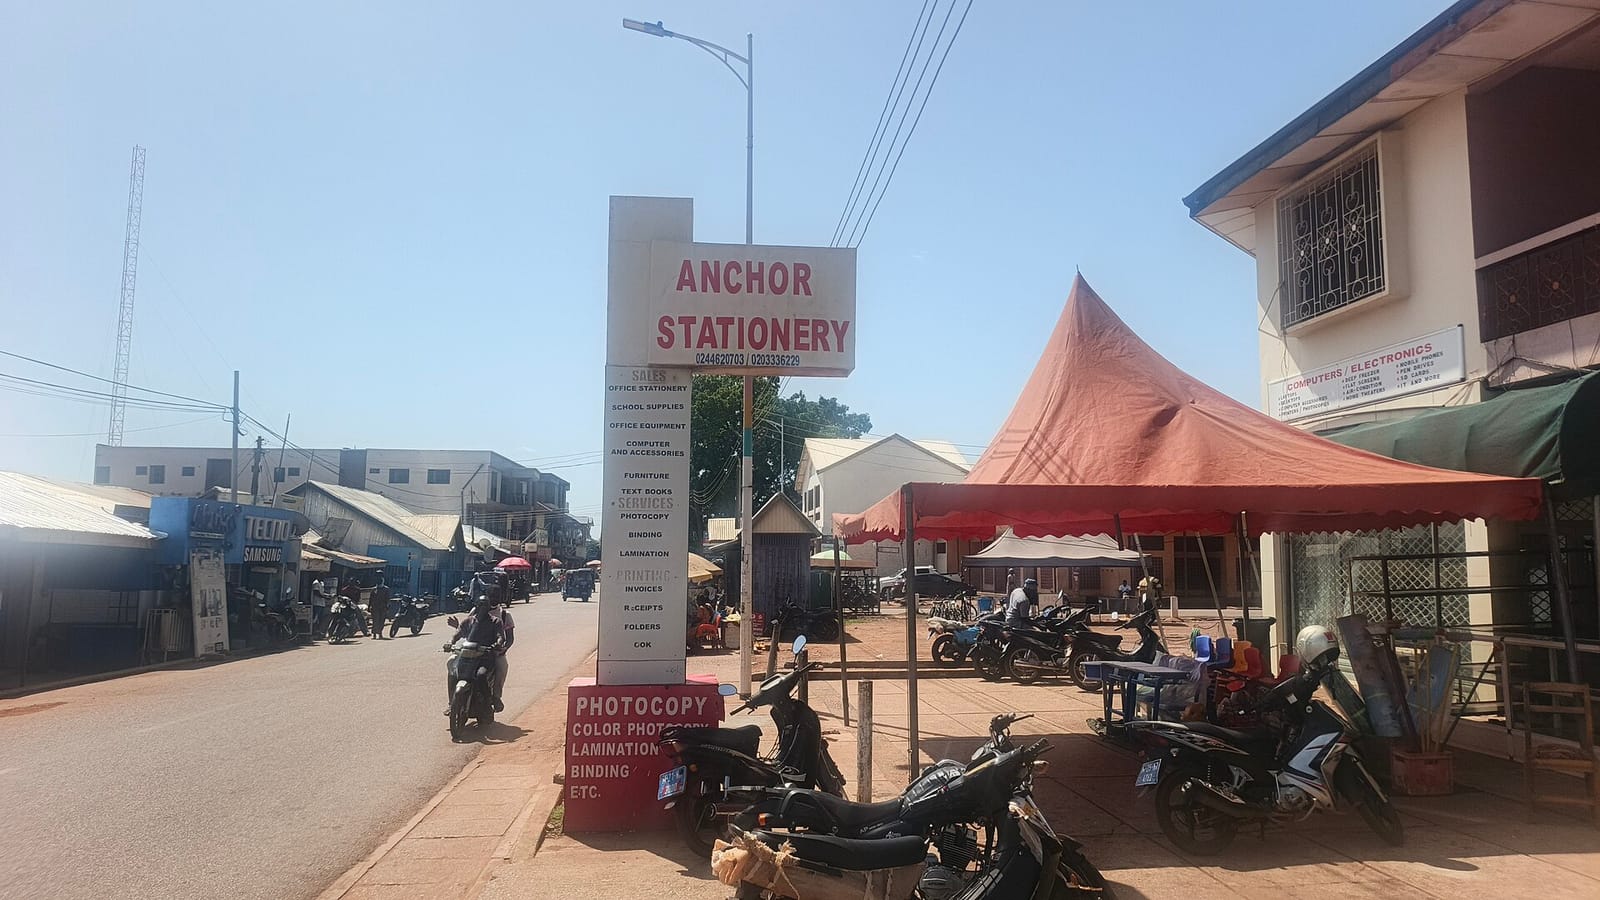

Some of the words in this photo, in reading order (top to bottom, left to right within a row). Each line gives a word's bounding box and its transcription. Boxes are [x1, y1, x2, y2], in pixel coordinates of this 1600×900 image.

[676, 260, 812, 296] ANCHOR
[656, 316, 850, 352] STATIONERY
[696, 352, 744, 365] 0244620703
[752, 354, 800, 366] 0203336229
[1414, 361, 1434, 370] DRIVES
[1287, 369, 1342, 391] COMPUTERS
[1351, 343, 1432, 373] ELECTRONICS
[1411, 370, 1430, 378] CARDS
[632, 369, 666, 382] SALES
[618, 497, 673, 509] SERVICES
[246, 516, 290, 540] TECNO
[244, 547, 282, 562] SAMSUNG
[576, 696, 708, 716] PHOTOCOPY
[572, 722, 621, 736] COLOR
[627, 722, 709, 736] PHOT
[571, 742, 659, 756] LAMINATION
[571, 765, 630, 778] BINDING
[571, 785, 601, 799] ETC.
